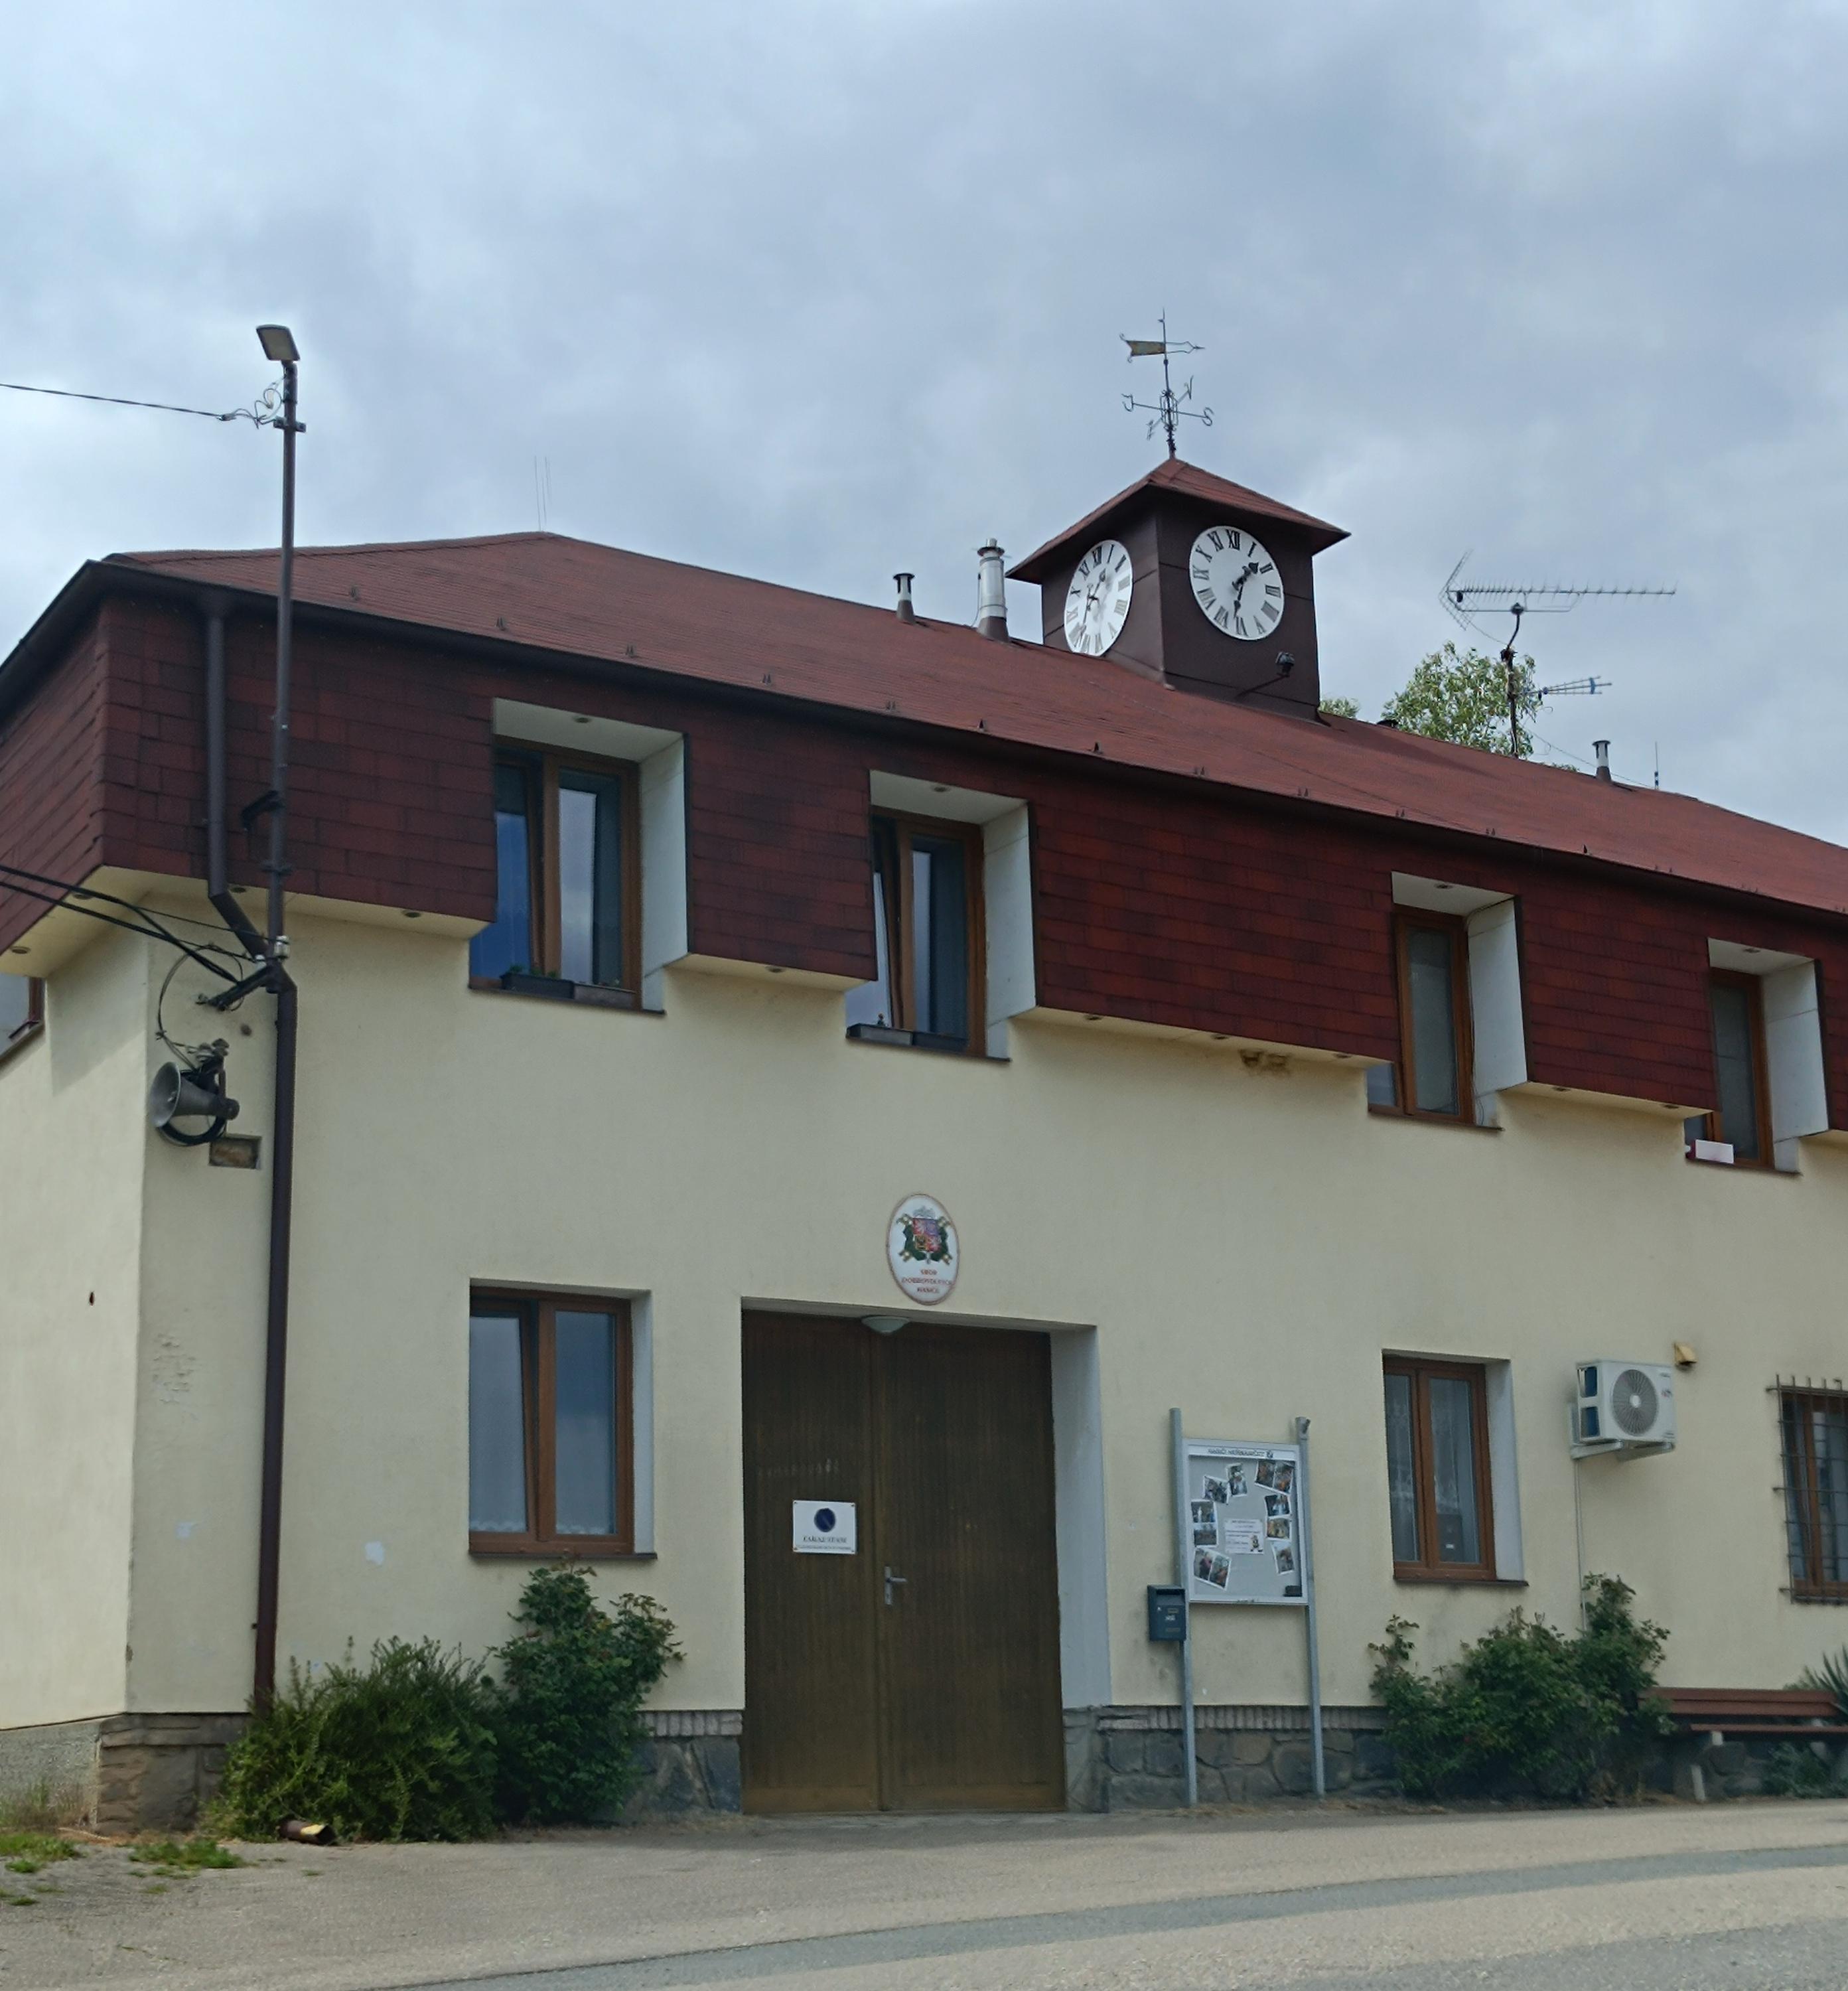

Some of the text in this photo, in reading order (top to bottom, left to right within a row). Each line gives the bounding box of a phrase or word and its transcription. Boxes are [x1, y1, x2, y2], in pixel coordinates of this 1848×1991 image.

[1195, 545, 1213, 563] X
[1247, 542, 1257, 558] I
[1259, 562, 1274, 574] II
